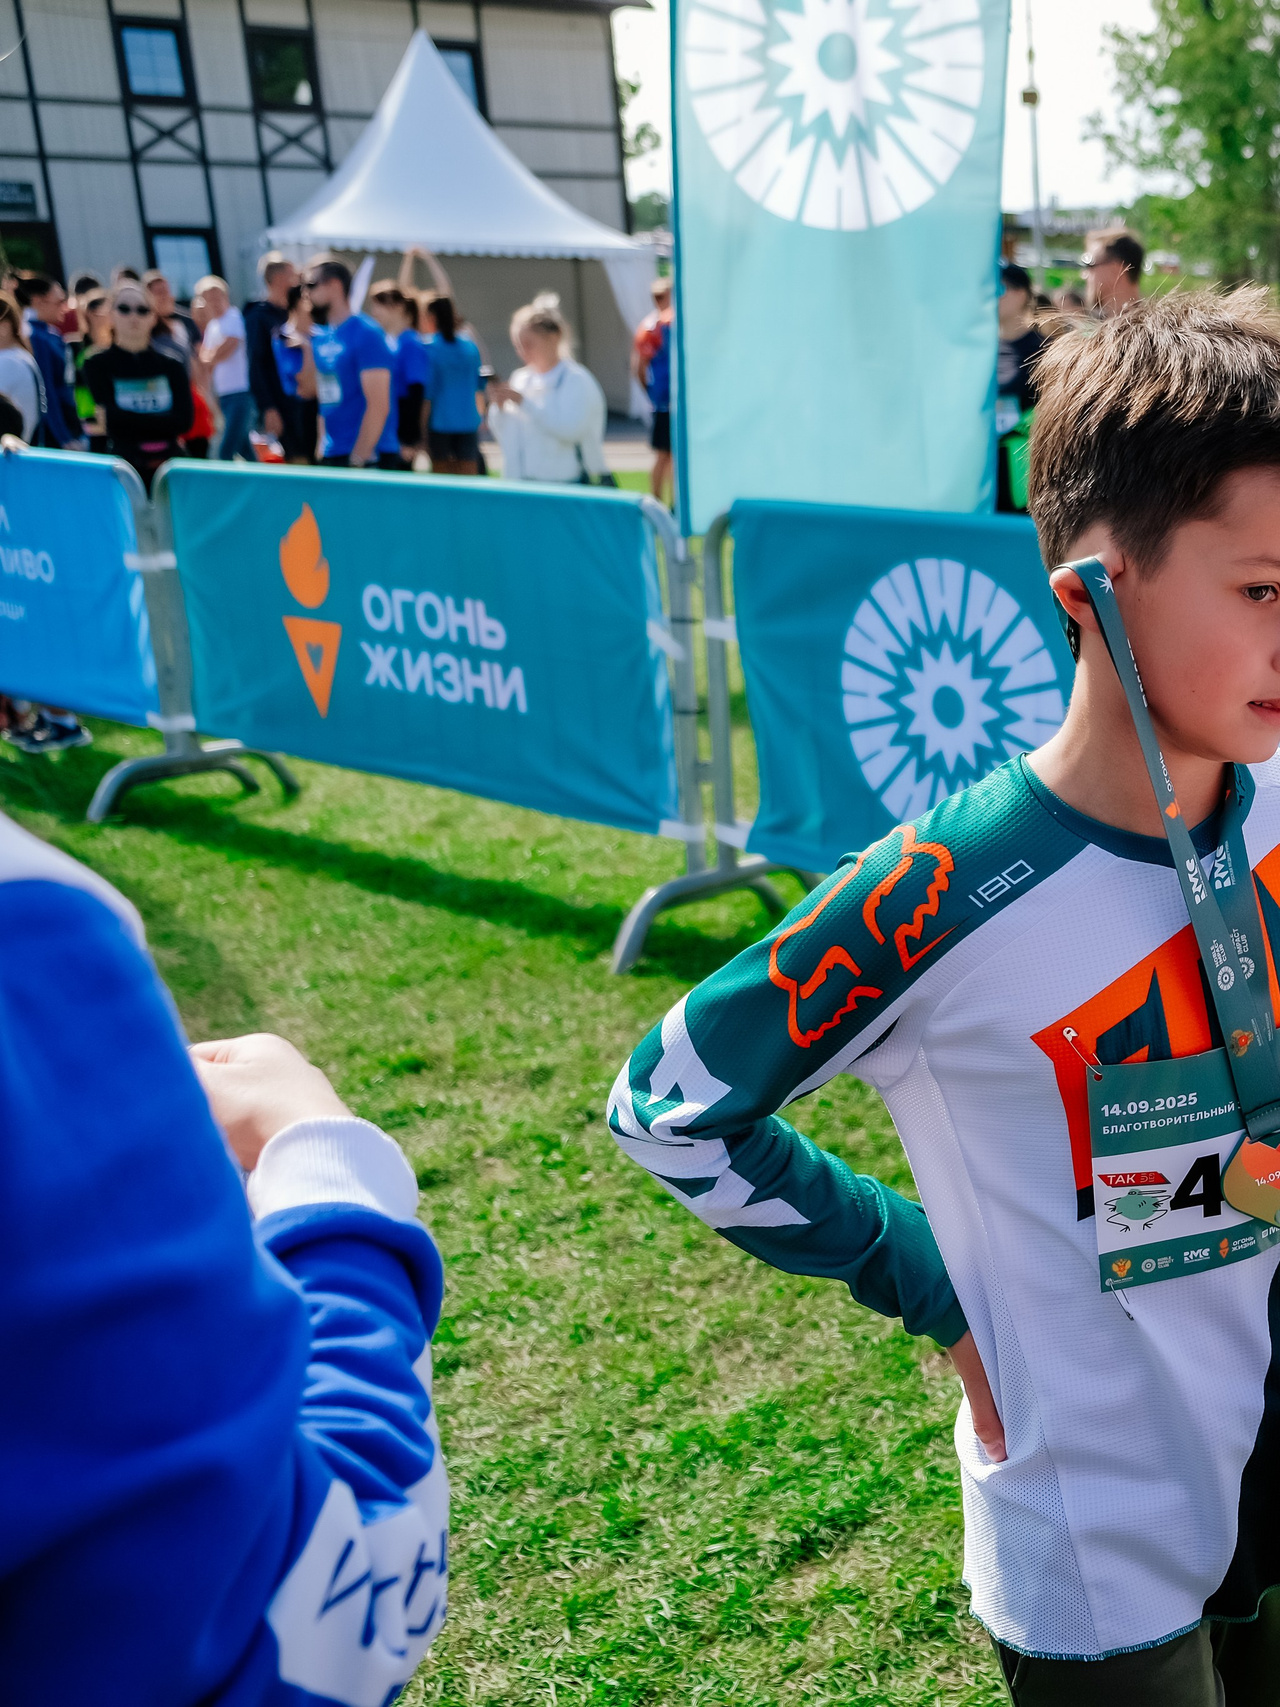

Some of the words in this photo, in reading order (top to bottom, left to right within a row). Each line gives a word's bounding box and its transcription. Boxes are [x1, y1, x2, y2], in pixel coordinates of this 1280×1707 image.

[361, 582, 508, 651] ОГОНЬ
[359, 640, 529, 715] ЖИЗНИ
[1240, 934, 1249, 953] CLUB
[1100, 1092, 1198, 1118] 14.09.2025
[1102, 1100, 1236, 1135] БЛАГОТВОРИТЕЛЬНЫЙ
[1107, 1173, 1136, 1186] ТАК
